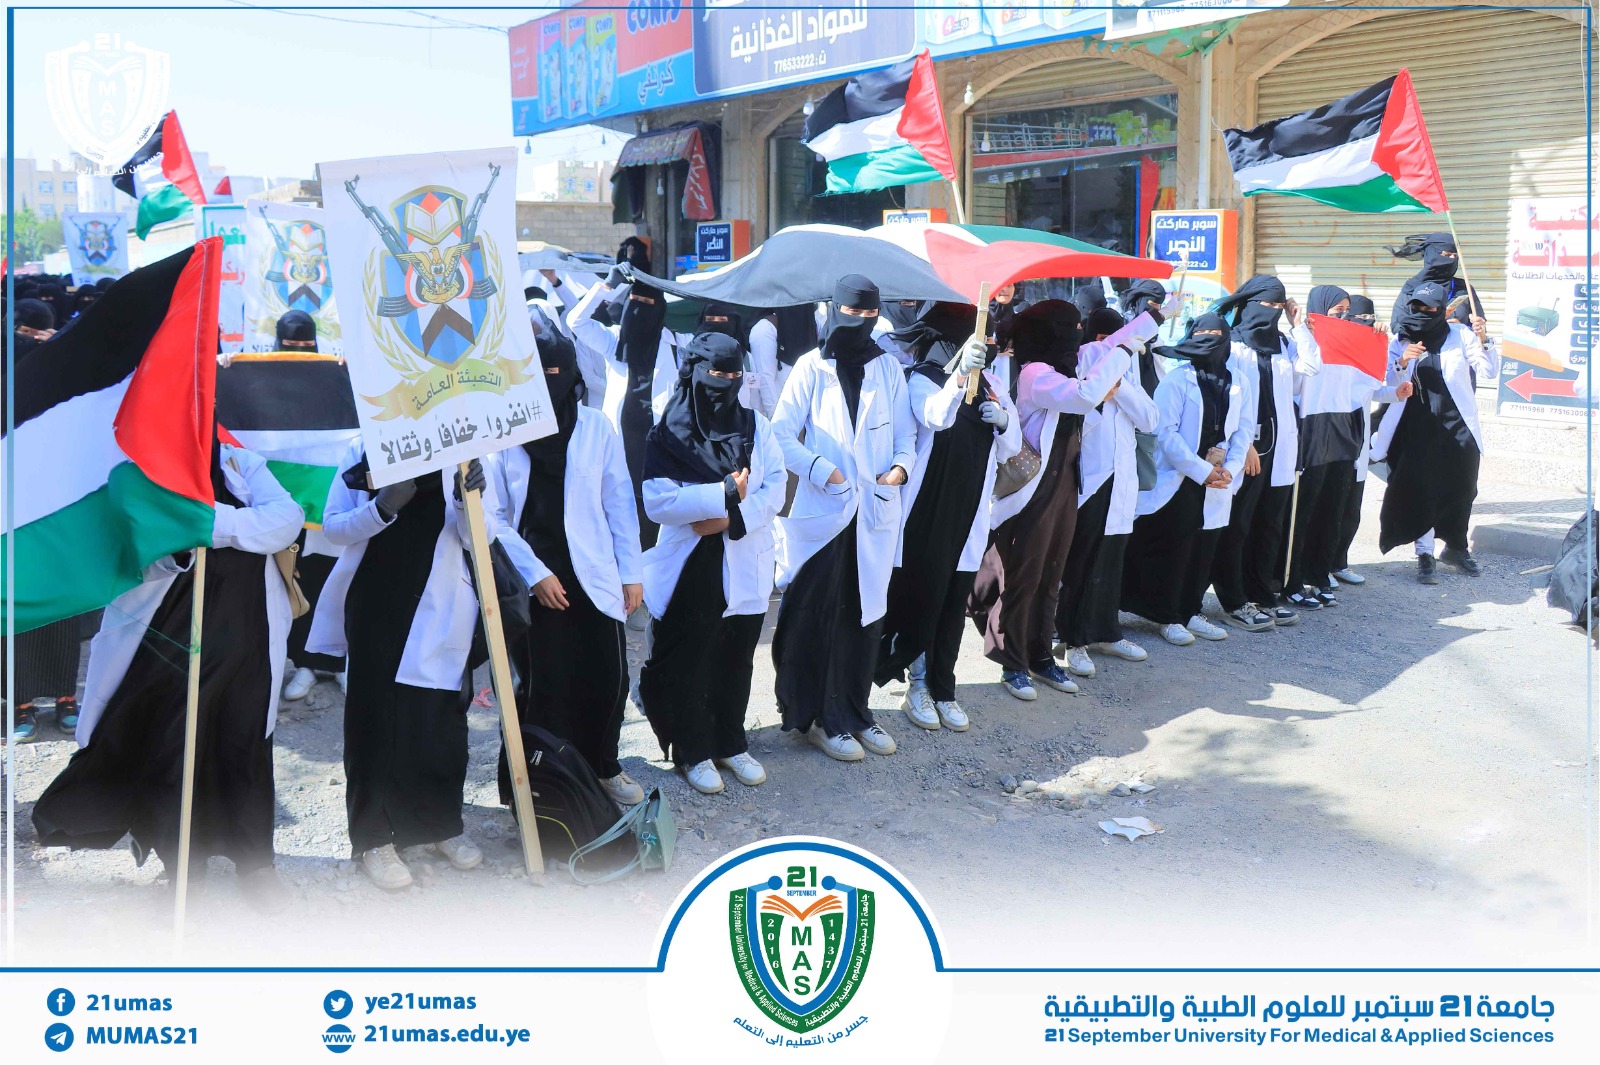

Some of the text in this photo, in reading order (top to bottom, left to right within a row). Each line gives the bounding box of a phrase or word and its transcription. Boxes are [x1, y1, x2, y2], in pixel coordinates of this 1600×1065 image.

[731, 10, 802, 63] الغذائية
[1157, 218, 1217, 231] سوبر ماركت
[1166, 236, 1206, 255] النصر
[411, 368, 502, 411] التعبئة العامة
